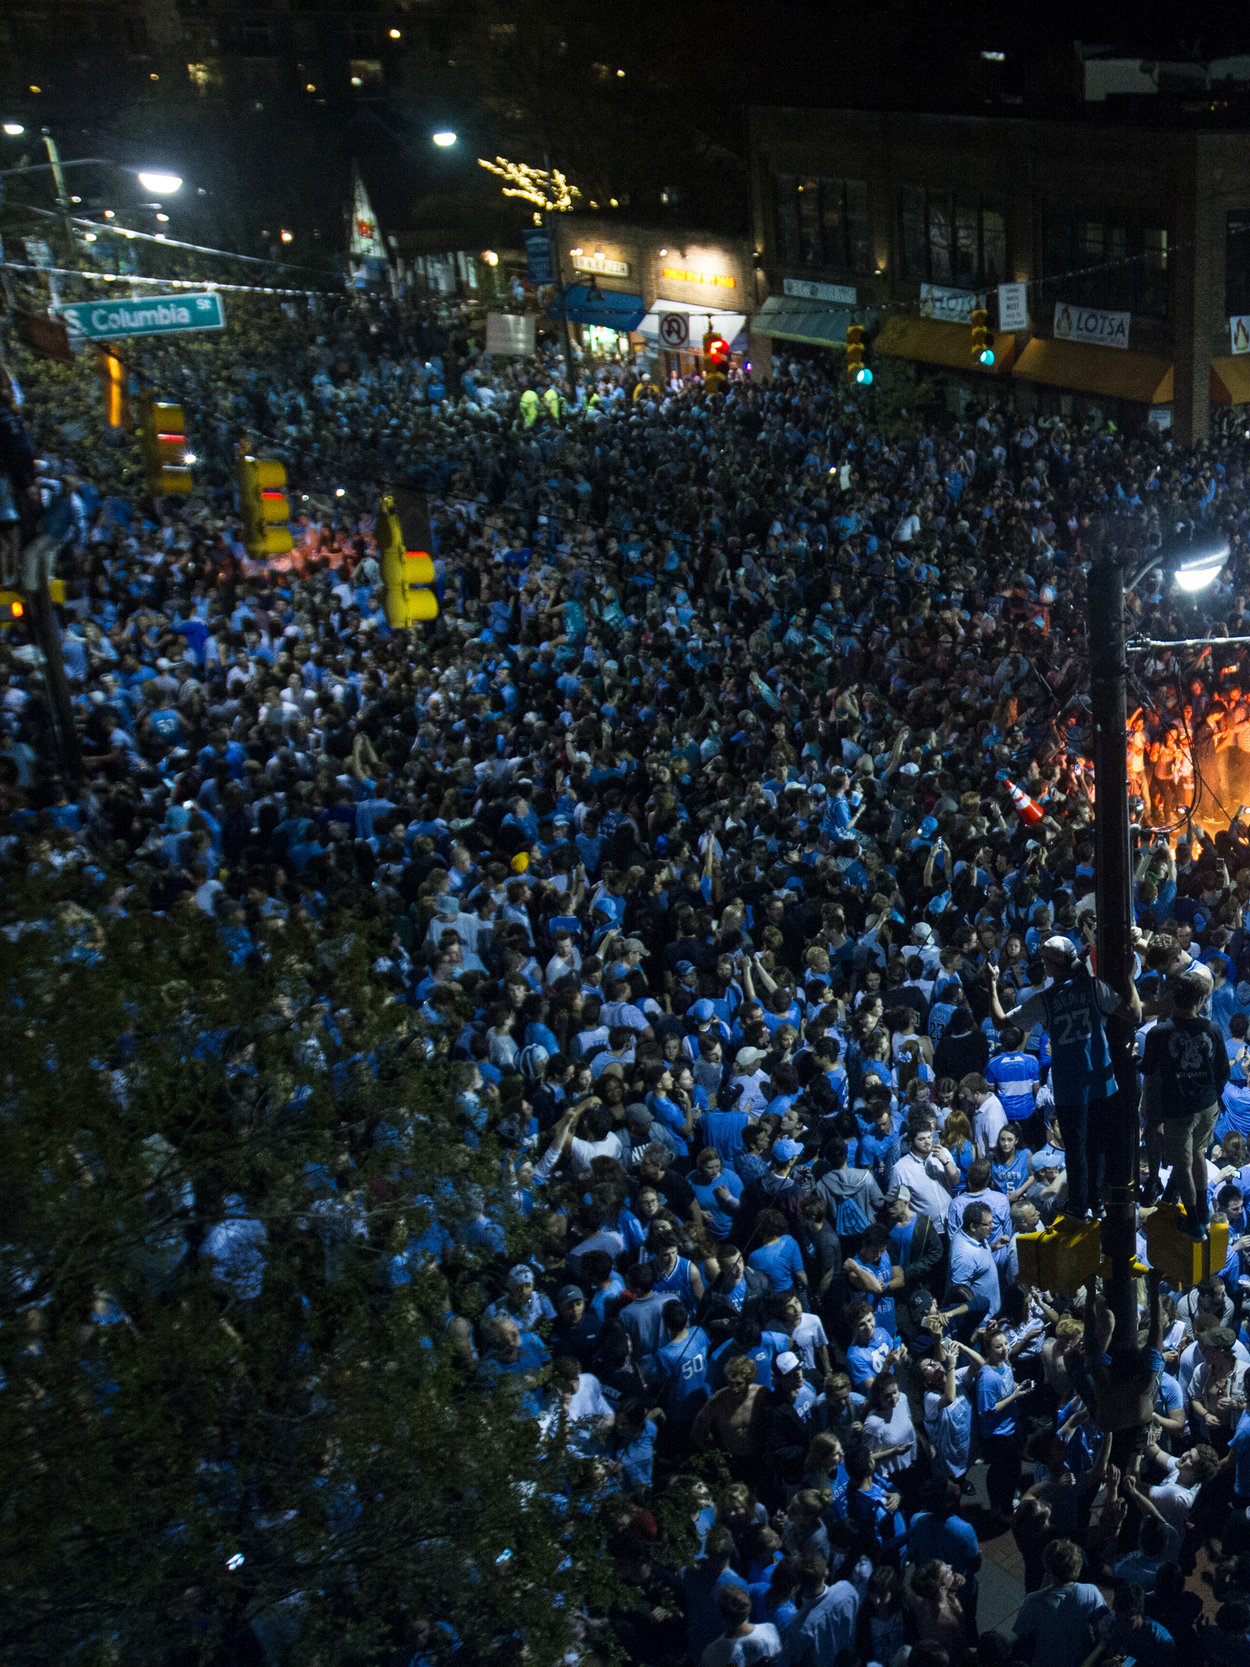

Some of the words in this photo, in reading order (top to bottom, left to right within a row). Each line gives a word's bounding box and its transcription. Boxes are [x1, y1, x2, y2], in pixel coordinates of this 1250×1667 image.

[91, 303, 190, 330] Columbia
[196, 298, 211, 310] St
[1077, 311, 1126, 339] LOTSA
[1053, 1007, 1093, 1045] 23
[632, 1142, 649, 1162] NI
[998, 1171, 1021, 1181] NORTH
[682, 1353, 704, 1381] 50
